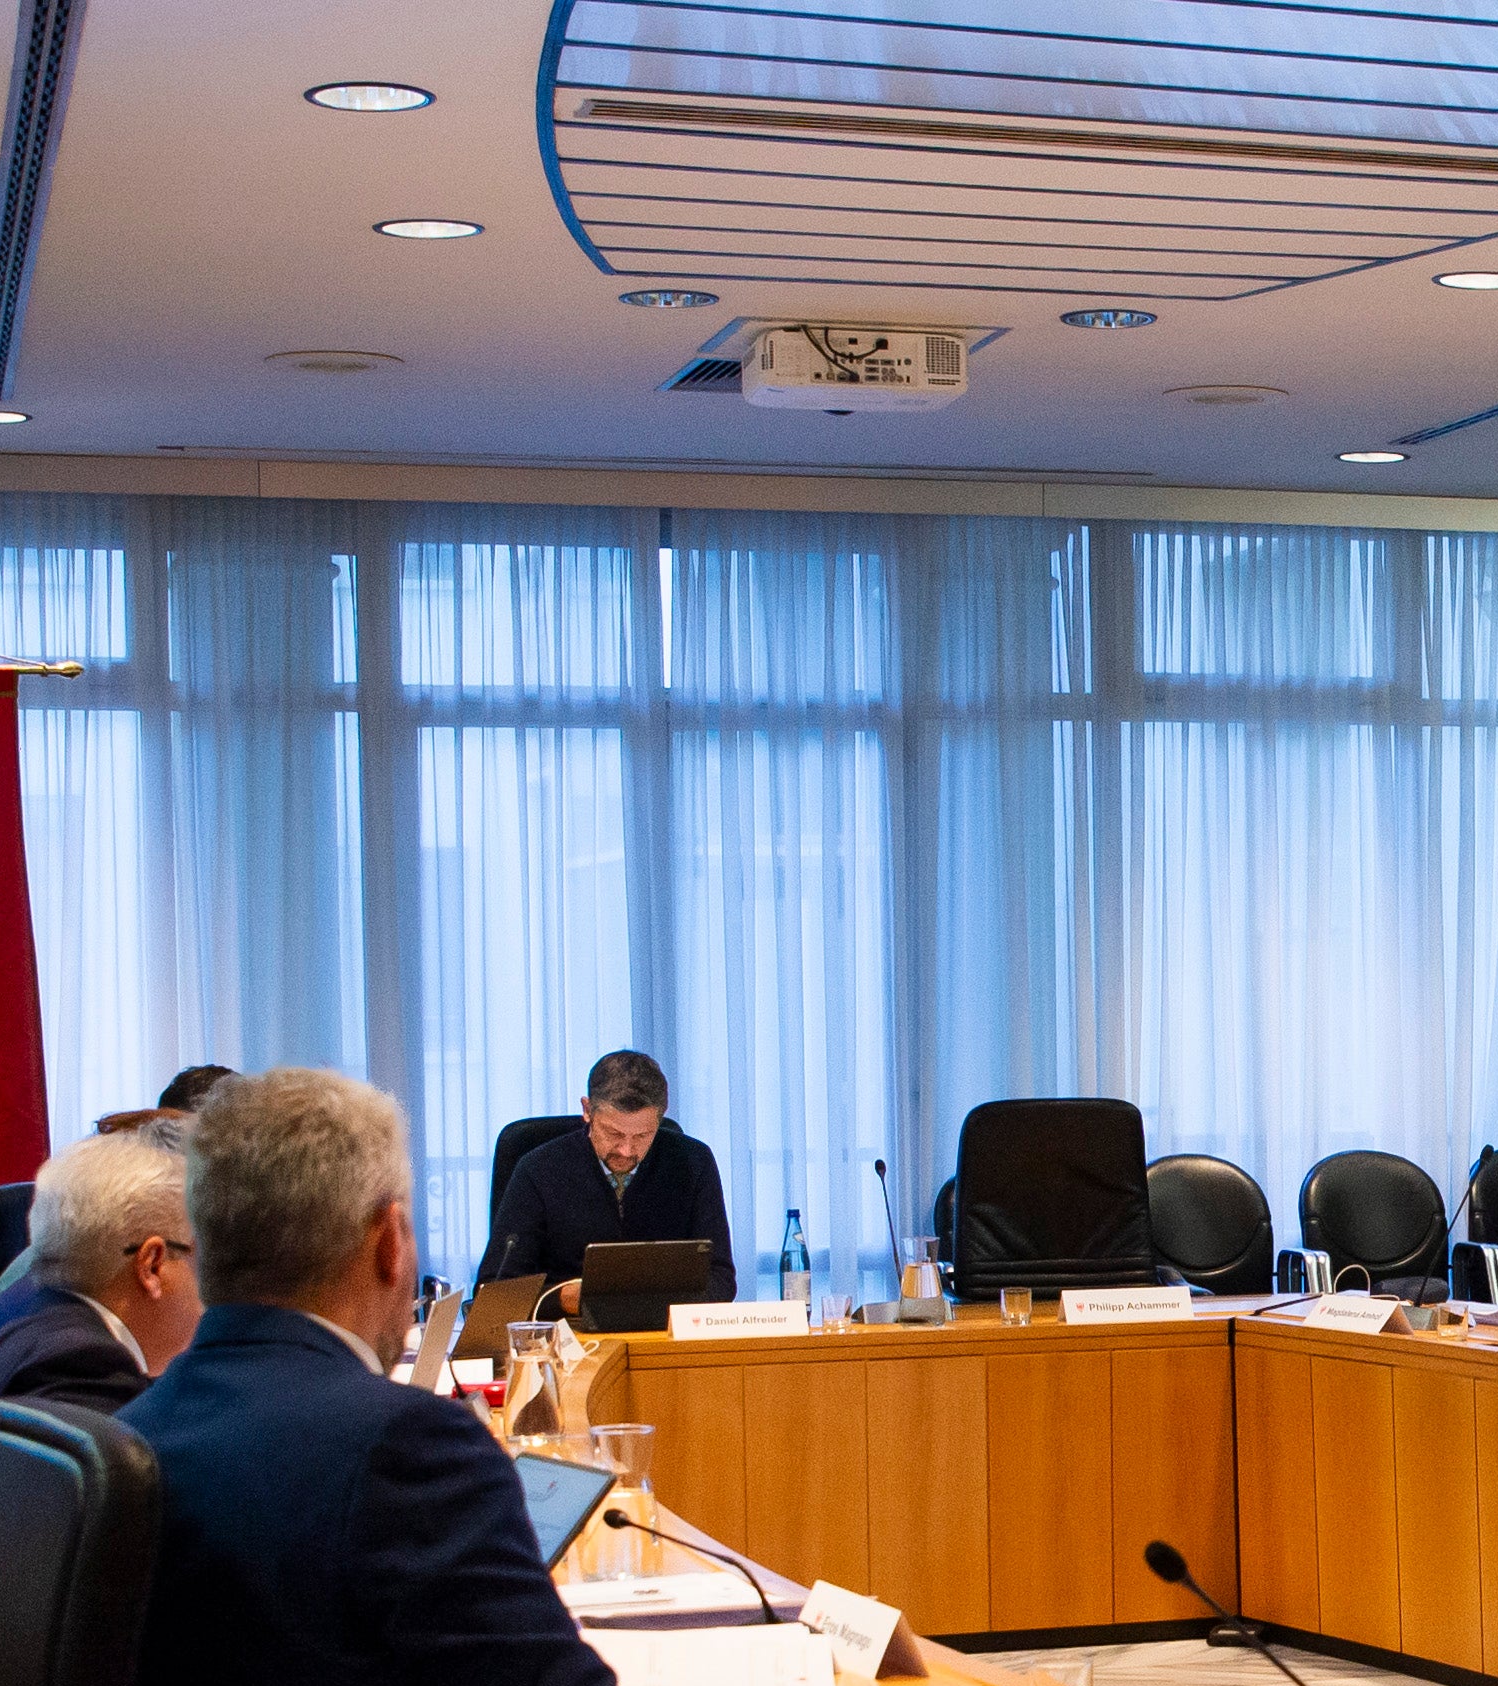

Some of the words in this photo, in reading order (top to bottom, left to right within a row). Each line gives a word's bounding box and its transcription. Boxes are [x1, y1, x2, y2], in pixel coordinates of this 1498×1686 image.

[1089, 1302, 1124, 1312] Philipp
[1126, 1301, 1181, 1311] Achammer
[705, 1316, 739, 1326] Daniel
[742, 1315, 787, 1325] Alfreider
